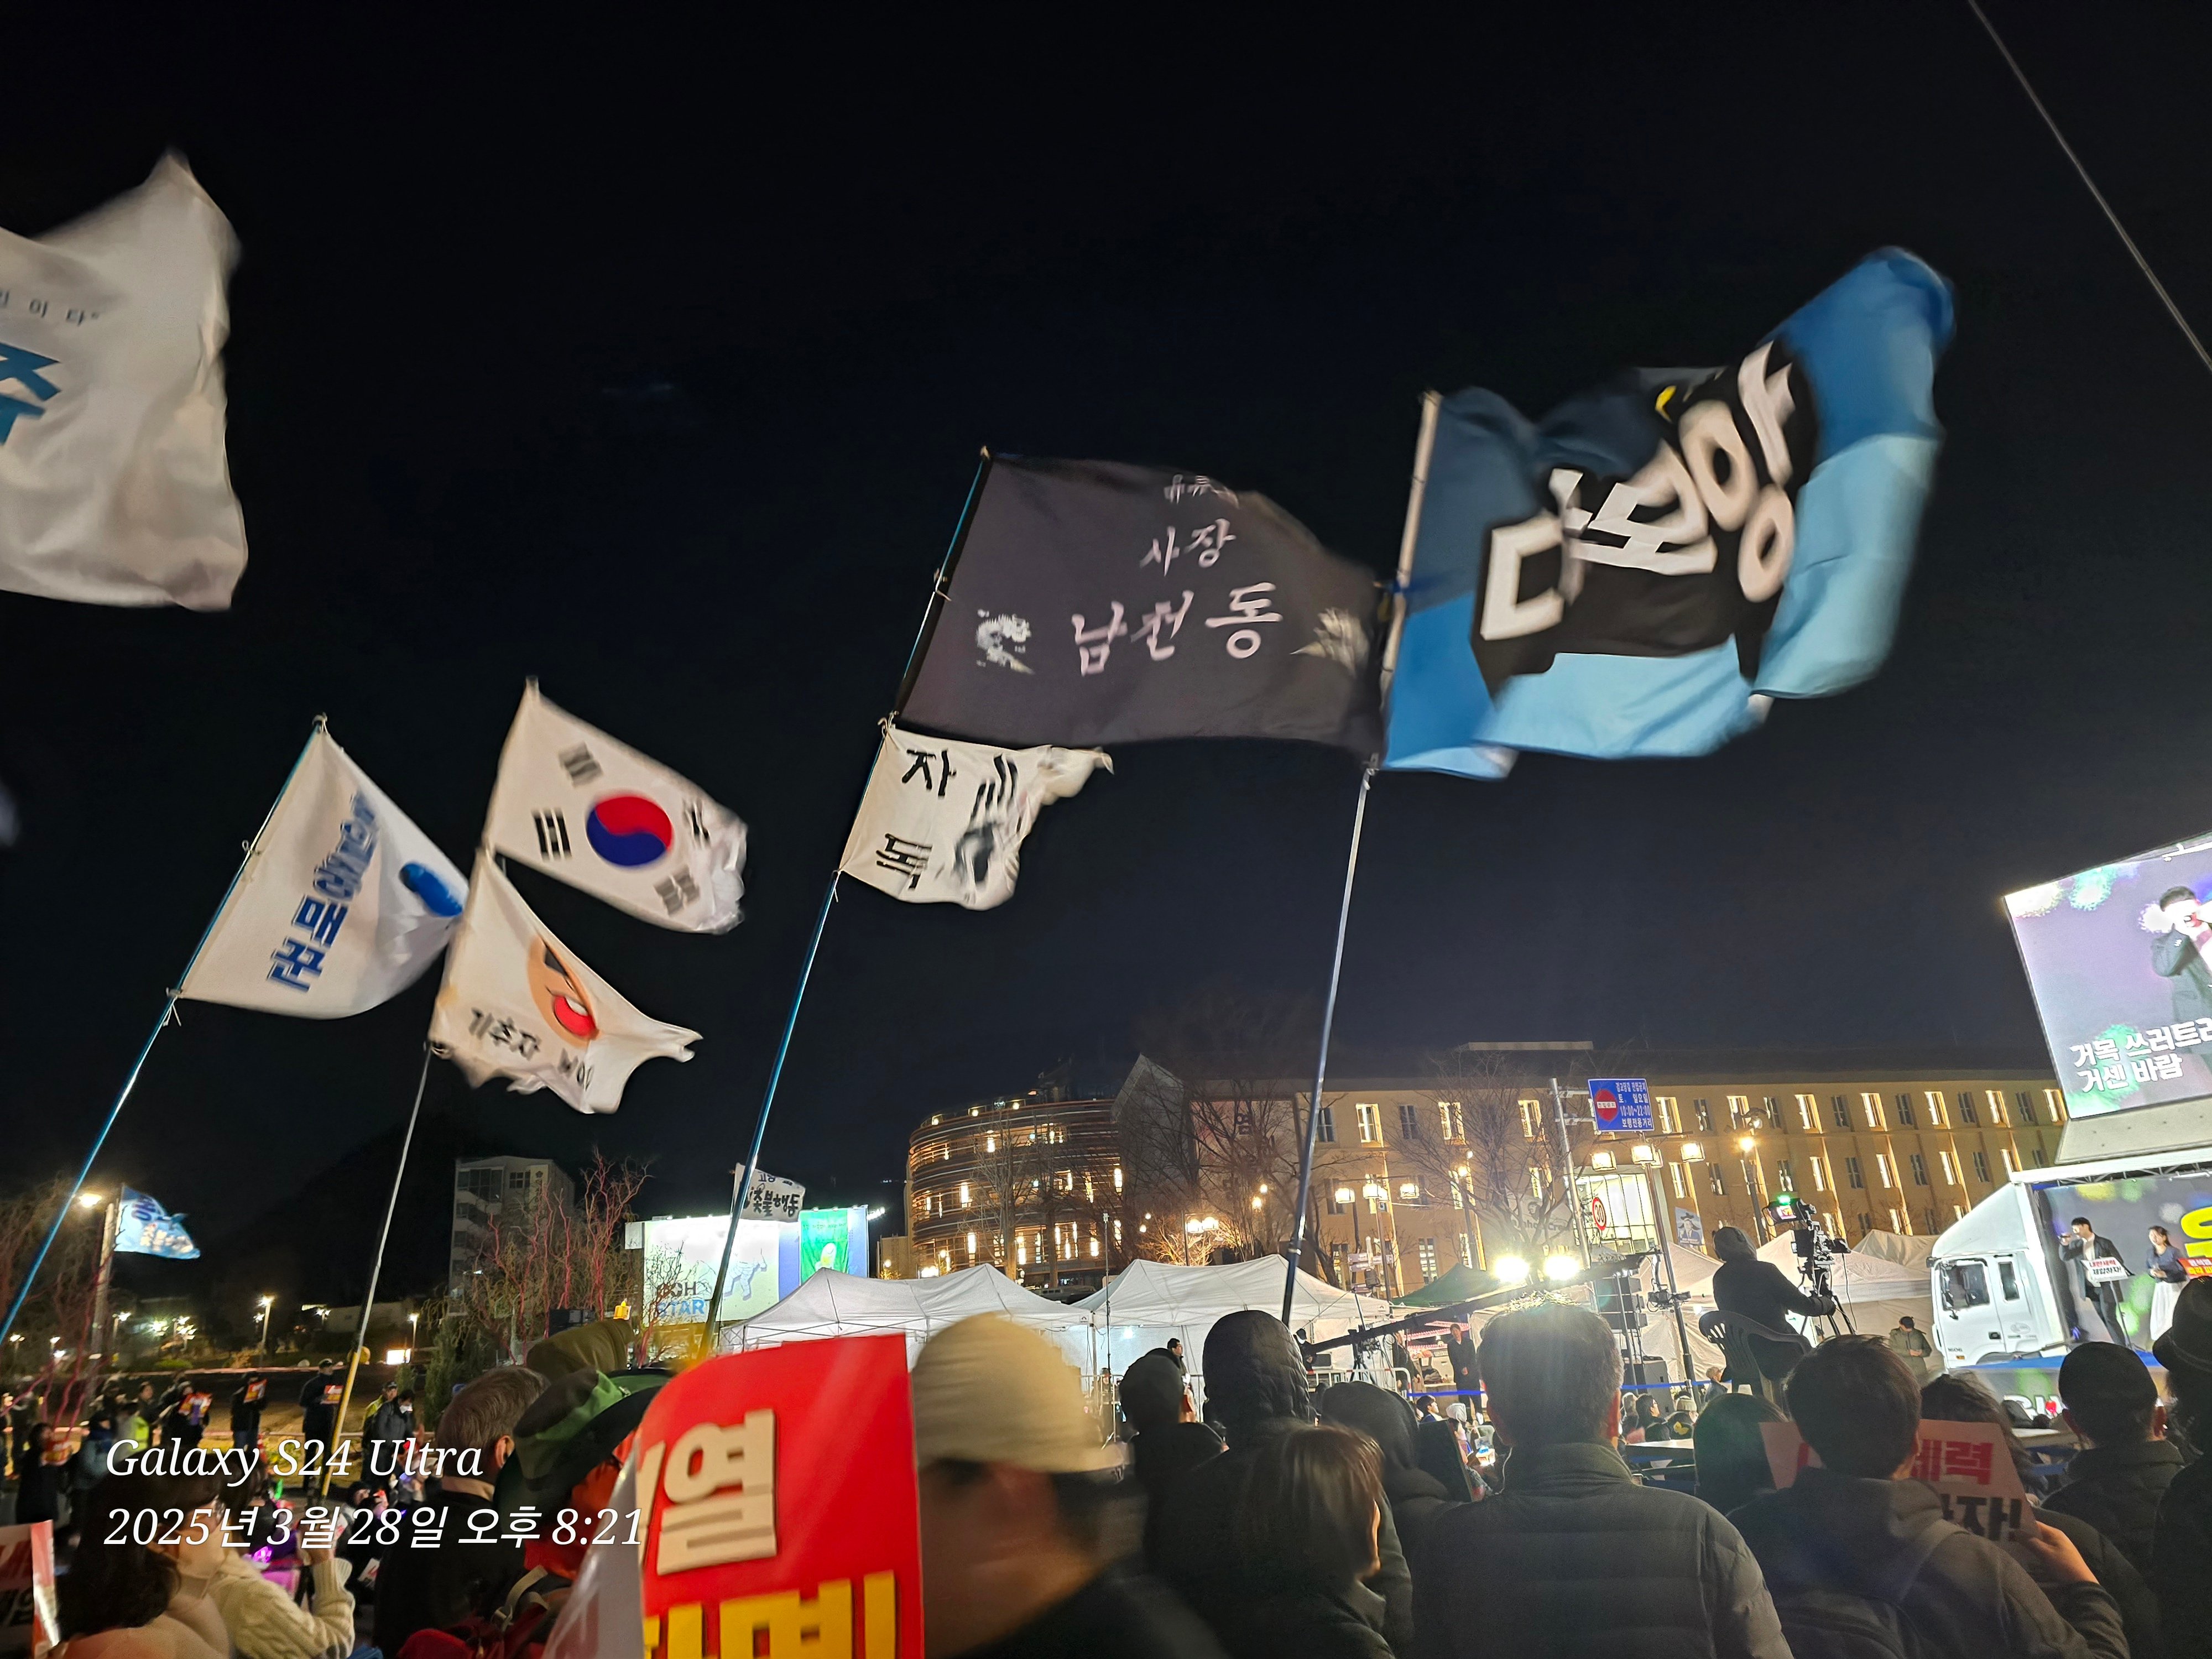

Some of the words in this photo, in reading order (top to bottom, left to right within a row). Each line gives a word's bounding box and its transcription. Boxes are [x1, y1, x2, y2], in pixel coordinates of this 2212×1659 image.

[1140, 518, 1237, 577] 사장
[1071, 582, 1283, 677] 남천동
[2070, 1038, 2120, 1067] 거목
[2077, 1064, 2129, 1093] 거센
[2131, 1053, 2183, 1083] 바람
[1620, 1105, 1651, 1117] 10:00~22:00
[1632, 1093, 1648, 1103] 일요일
[1622, 1118, 1652, 1128] 보행전용거리
[753, 1188, 800, 1218] 촛불행동
[1595, 1204, 1604, 1223] 30
